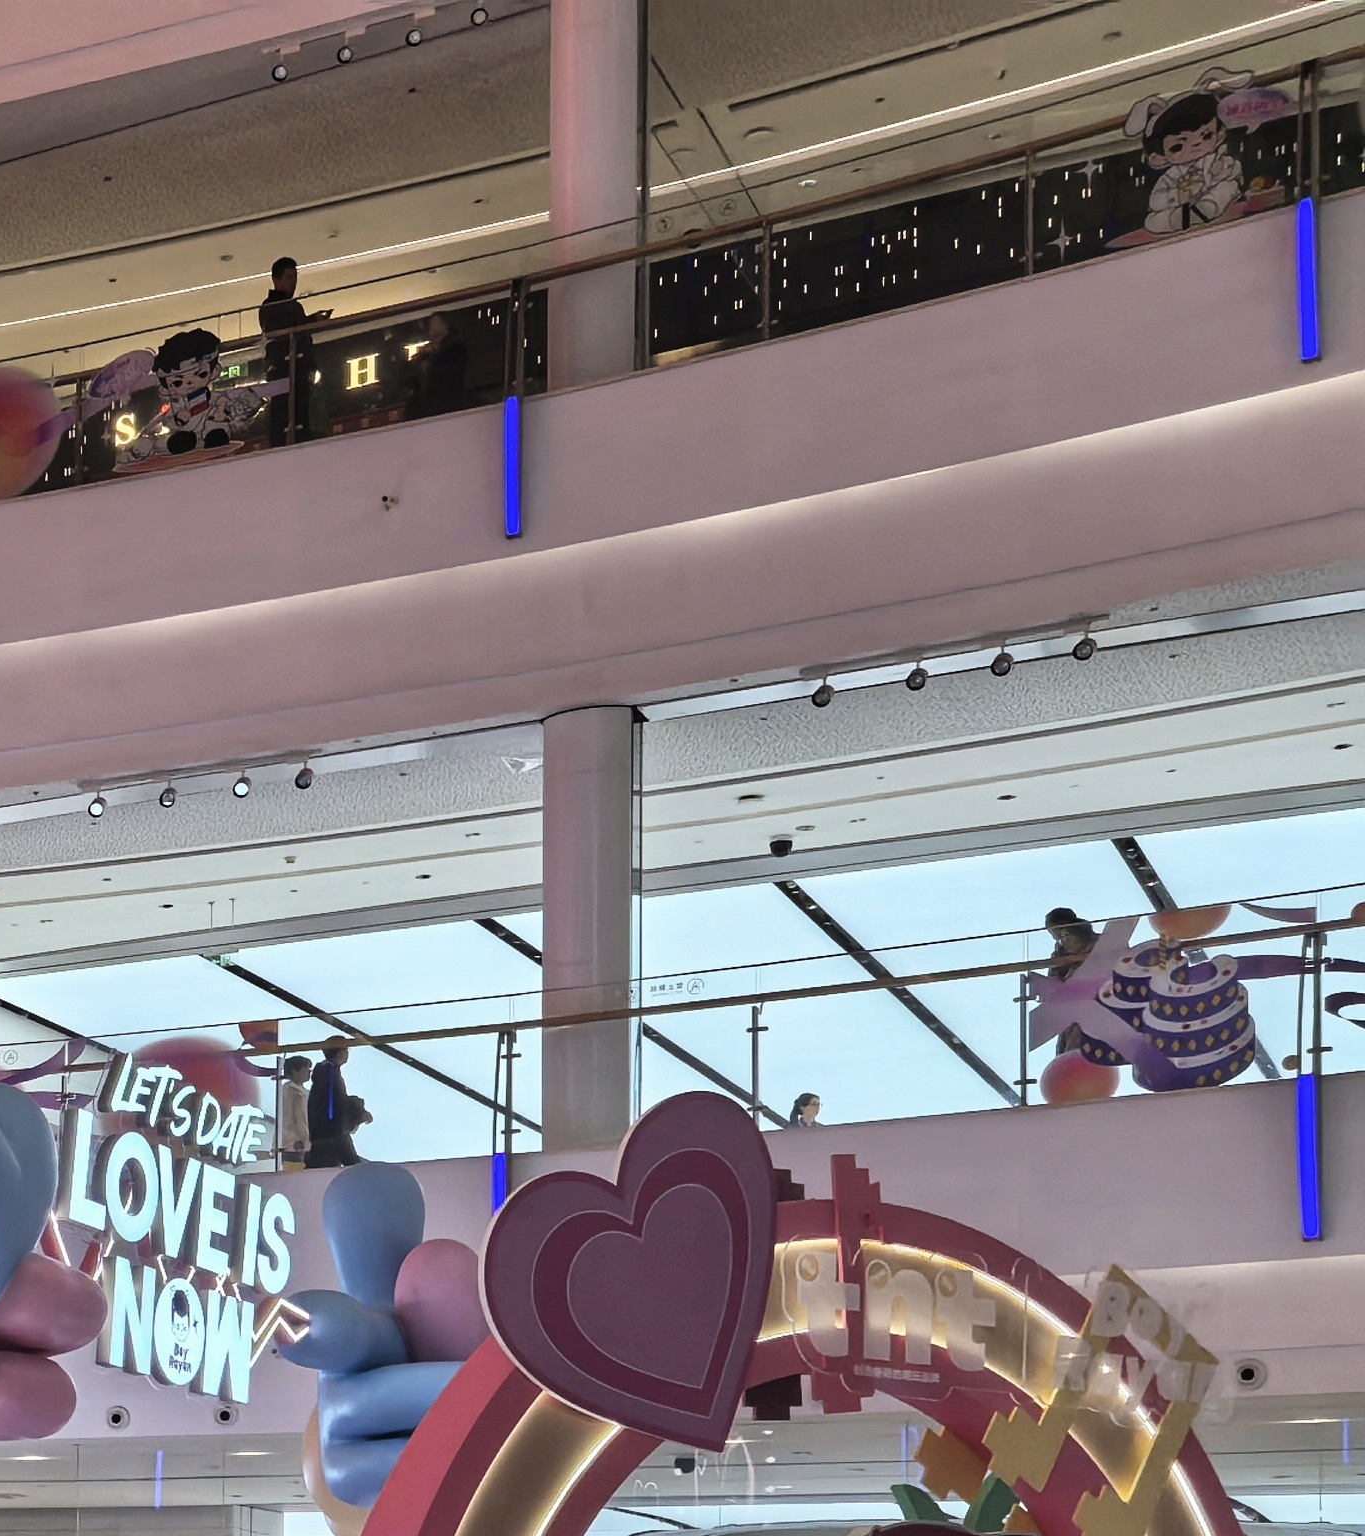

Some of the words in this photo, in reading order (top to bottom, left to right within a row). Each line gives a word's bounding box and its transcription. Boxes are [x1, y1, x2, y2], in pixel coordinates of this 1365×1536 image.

[111, 1052, 195, 1137] LET'S
[196, 1092, 266, 1164] DATE
[69, 1108, 235, 1275] LOVE
[241, 1183, 297, 1295] IS
[109, 1256, 255, 1405] NOW
[796, 1251, 997, 1372] tnt
